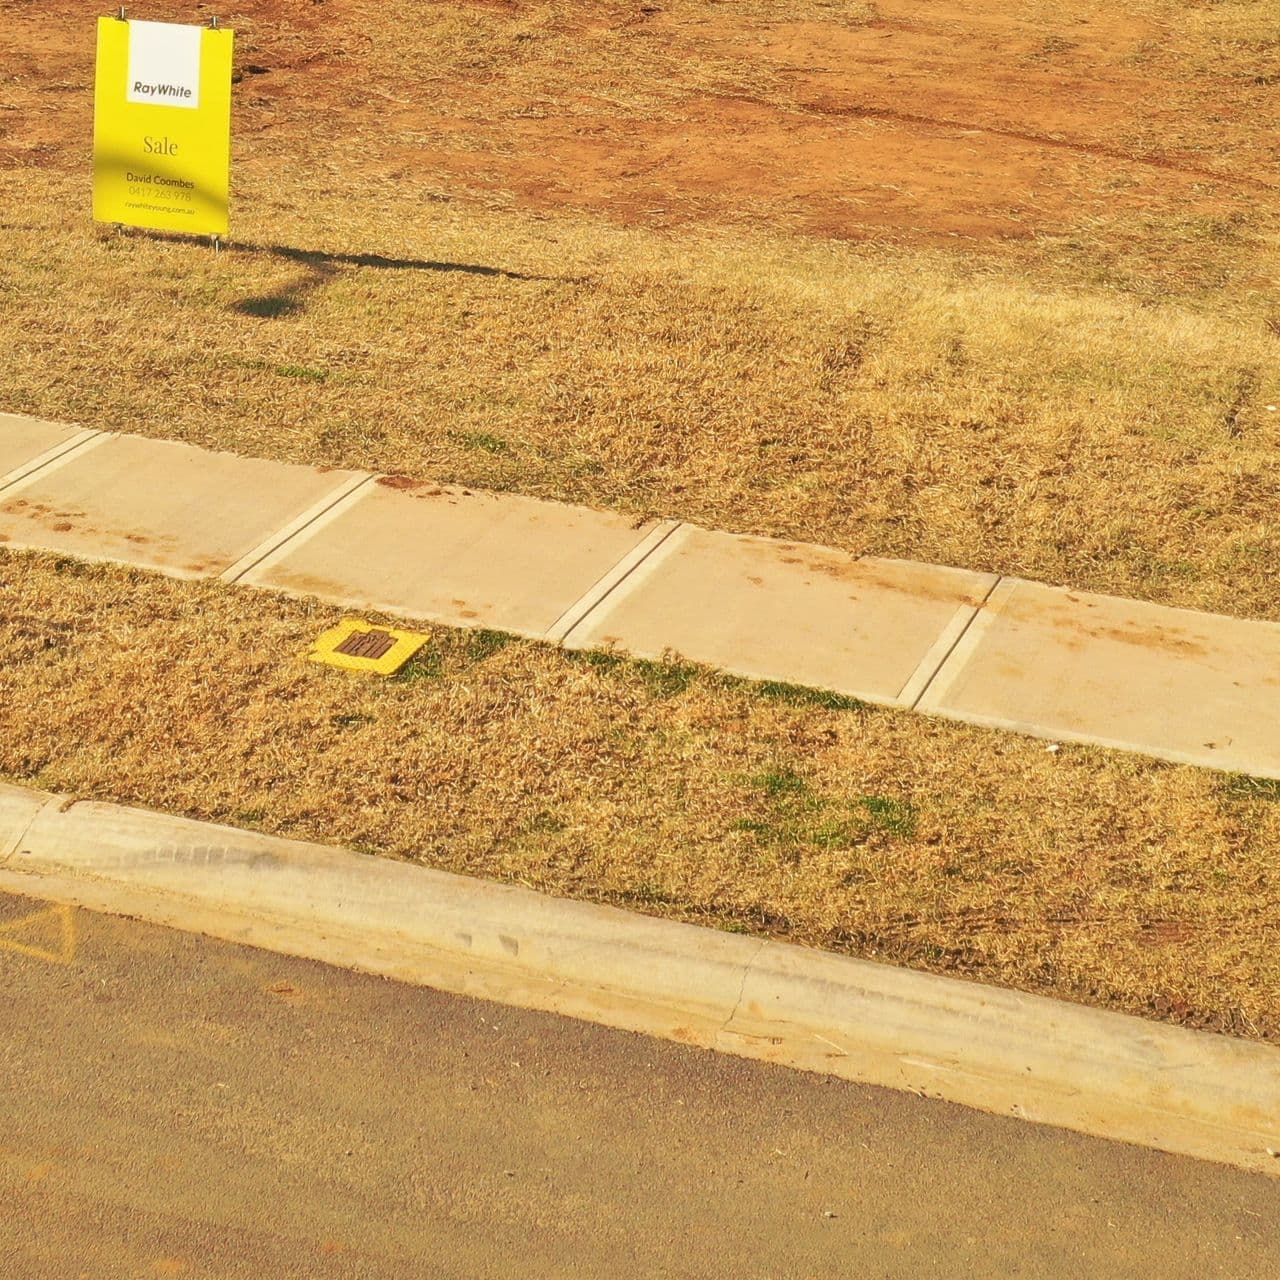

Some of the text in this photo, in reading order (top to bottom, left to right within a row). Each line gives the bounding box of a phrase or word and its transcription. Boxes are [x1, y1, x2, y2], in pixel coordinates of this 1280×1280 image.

[143, 136, 178, 156] Sale
[126, 172, 195, 189] David Coombes
[128, 186, 152, 197] 0417
